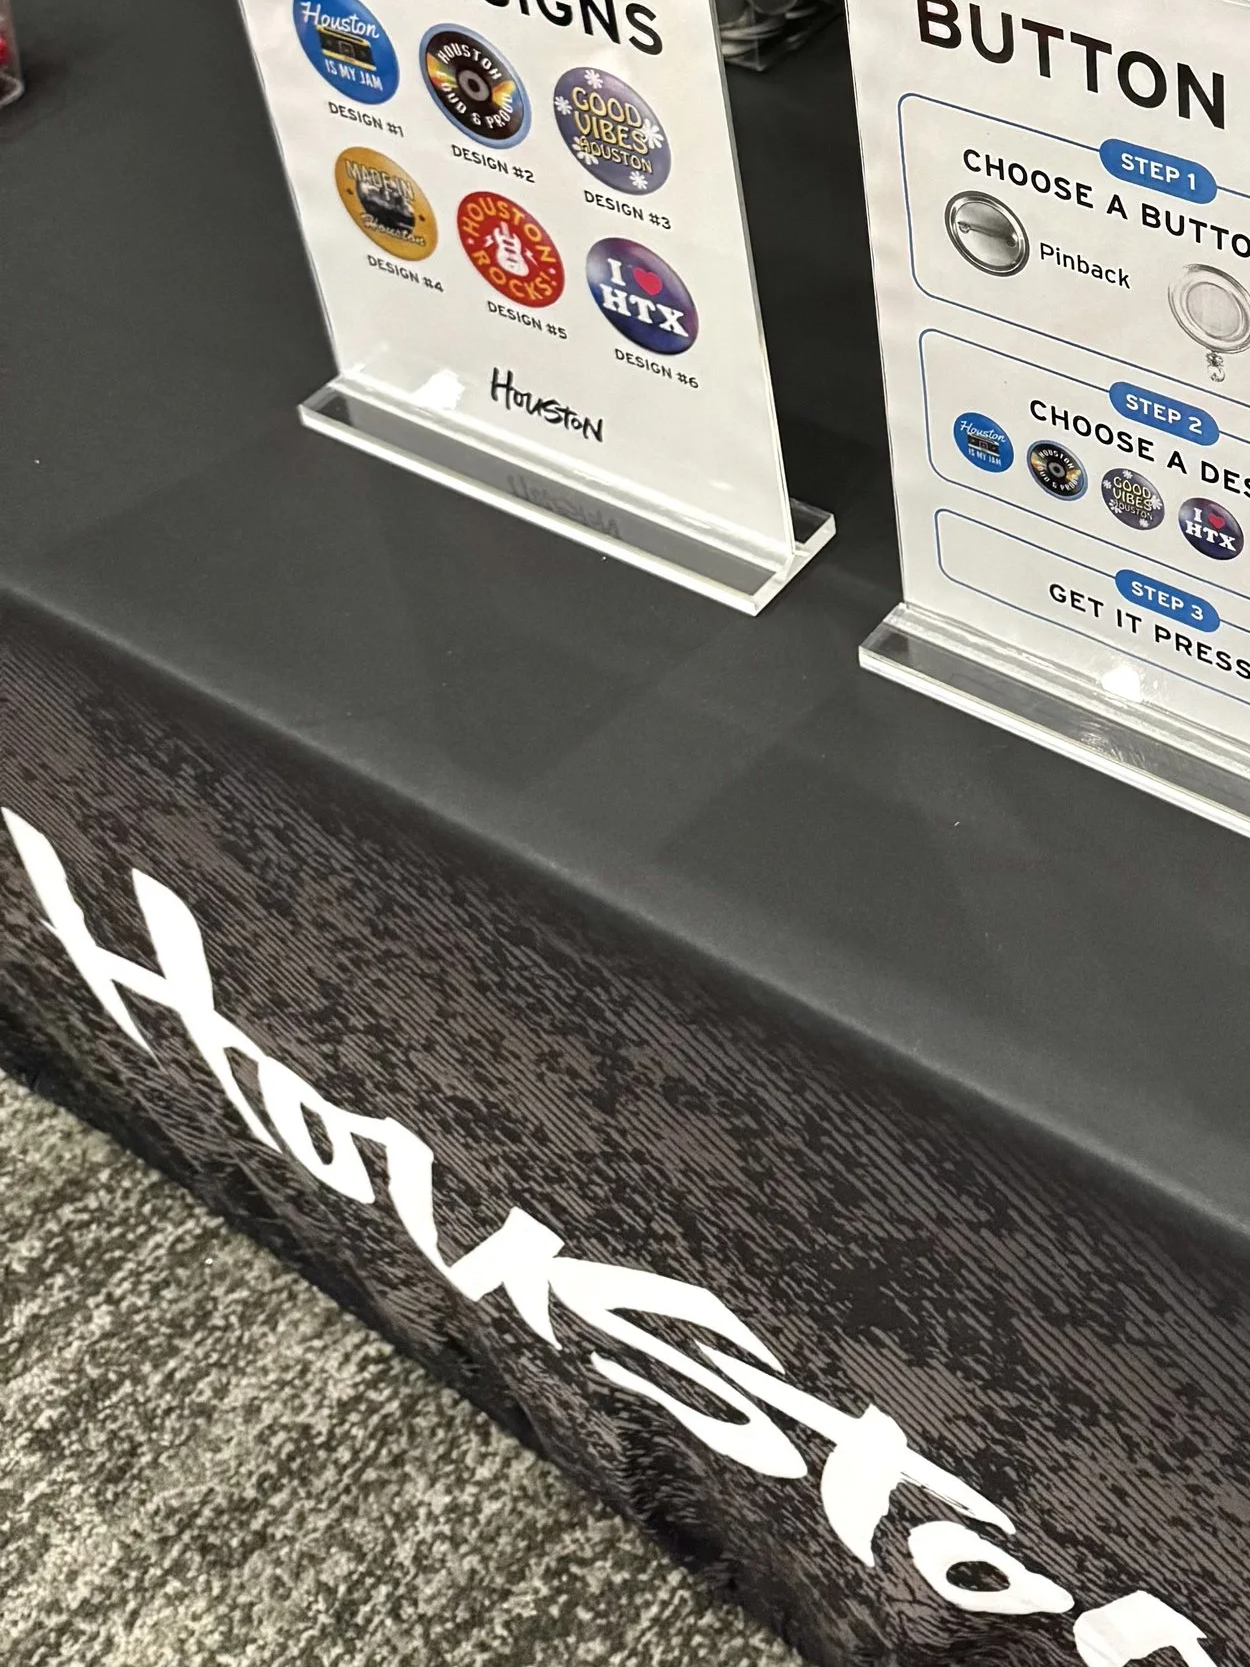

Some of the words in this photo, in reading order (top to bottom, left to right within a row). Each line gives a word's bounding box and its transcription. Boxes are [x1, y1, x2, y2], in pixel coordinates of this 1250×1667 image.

[300, 1, 379, 38] Houston
[325, 59, 337, 75] IS
[340, 64, 356, 82] MY
[359, 71, 383, 91] JAM
[437, 42, 502, 79] HOUSTON
[328, 101, 383, 130] DESIGN
[387, 122, 404, 137] #1
[572, 86, 642, 128] GOOD
[574, 111, 648, 155] VIBES
[451, 144, 508, 175] DESIGN
[512, 165, 535, 184] #2
[962, 148, 1094, 209] CHOOSE
[1106, 194, 1128, 220] A
[1121, 153, 1180, 184] STEP
[1187, 173, 1196, 191] 1
[461, 197, 556, 263] HOUSTON
[584, 190, 644, 221] DESIGN
[649, 212, 671, 230] #3
[367, 254, 419, 283] DESIGN
[423, 276, 444, 292] #4
[472, 251, 557, 300] ROCKS!
[607, 258, 626, 286] I
[1039, 243, 1131, 290] Pinback
[487, 300, 542, 331] DESIGN
[546, 323, 567, 339] #5
[600, 284, 689, 338] HTX
[614, 348, 672, 379] DESIGN
[677, 372, 698, 389] #6
[960, 420, 1006, 443] Houston
[1126, 394, 1182, 425] STEP
[1189, 416, 1202, 434] 2
[1030, 399, 1155, 463] CHOOSE
[1166, 450, 1188, 475] A
[1113, 476, 1151, 499] GOOD
[1113, 487, 1153, 511] VIBES
[1193, 508, 1203, 523] I
[1185, 520, 1237, 552] HTX
[1049, 583, 1104, 618] GET
[1116, 609, 1142, 634] IT
[1131, 580, 1184, 611] STEP
[1191, 604, 1204, 621] 3
